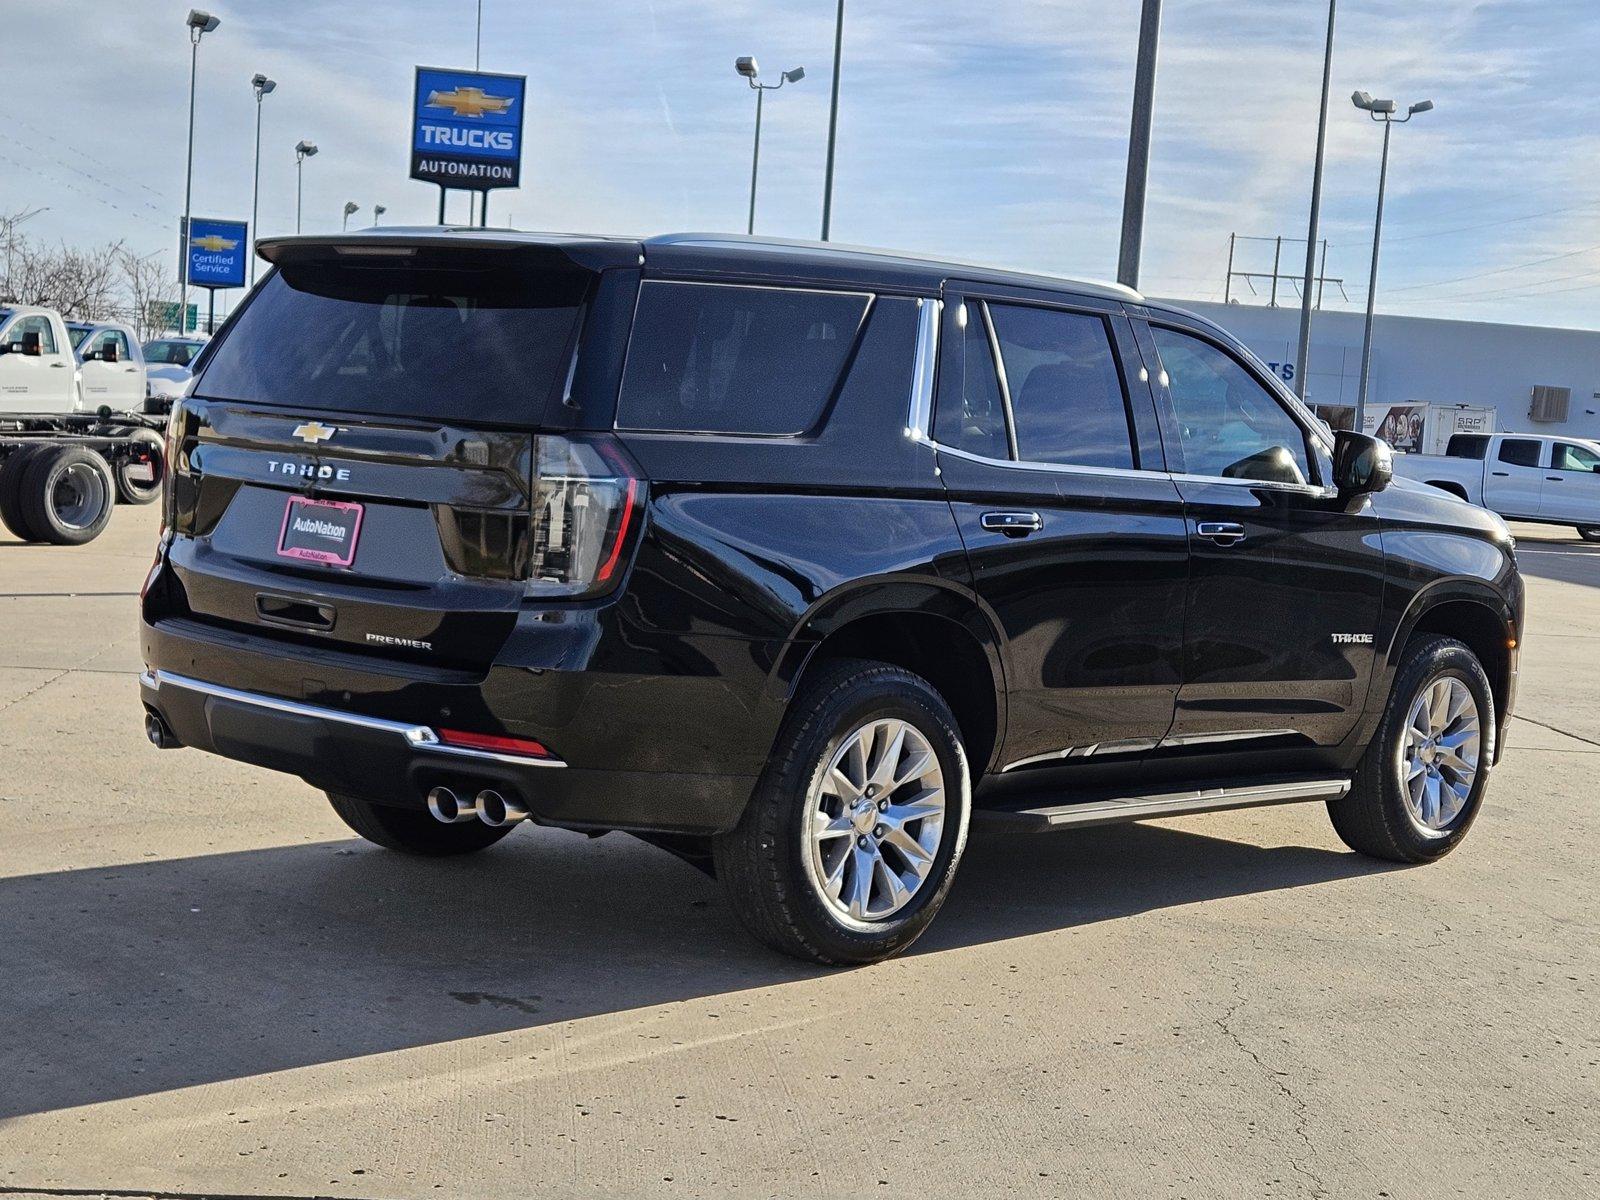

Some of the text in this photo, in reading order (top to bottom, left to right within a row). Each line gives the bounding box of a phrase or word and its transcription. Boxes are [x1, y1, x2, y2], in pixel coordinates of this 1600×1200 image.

[421, 125, 513, 150] TRUCKS
[419, 160, 513, 179] AUTONATION
[192, 253, 234, 265] Certified
[195, 262, 231, 274] Service
[1457, 417, 1481, 426] SRP
[268, 460, 351, 481] TAHOE
[293, 517, 346, 538] AutoNation
[298, 549, 328, 561] AutoNation
[366, 633, 433, 651] PREMIER
[1331, 633, 1374, 643] TAHOE
